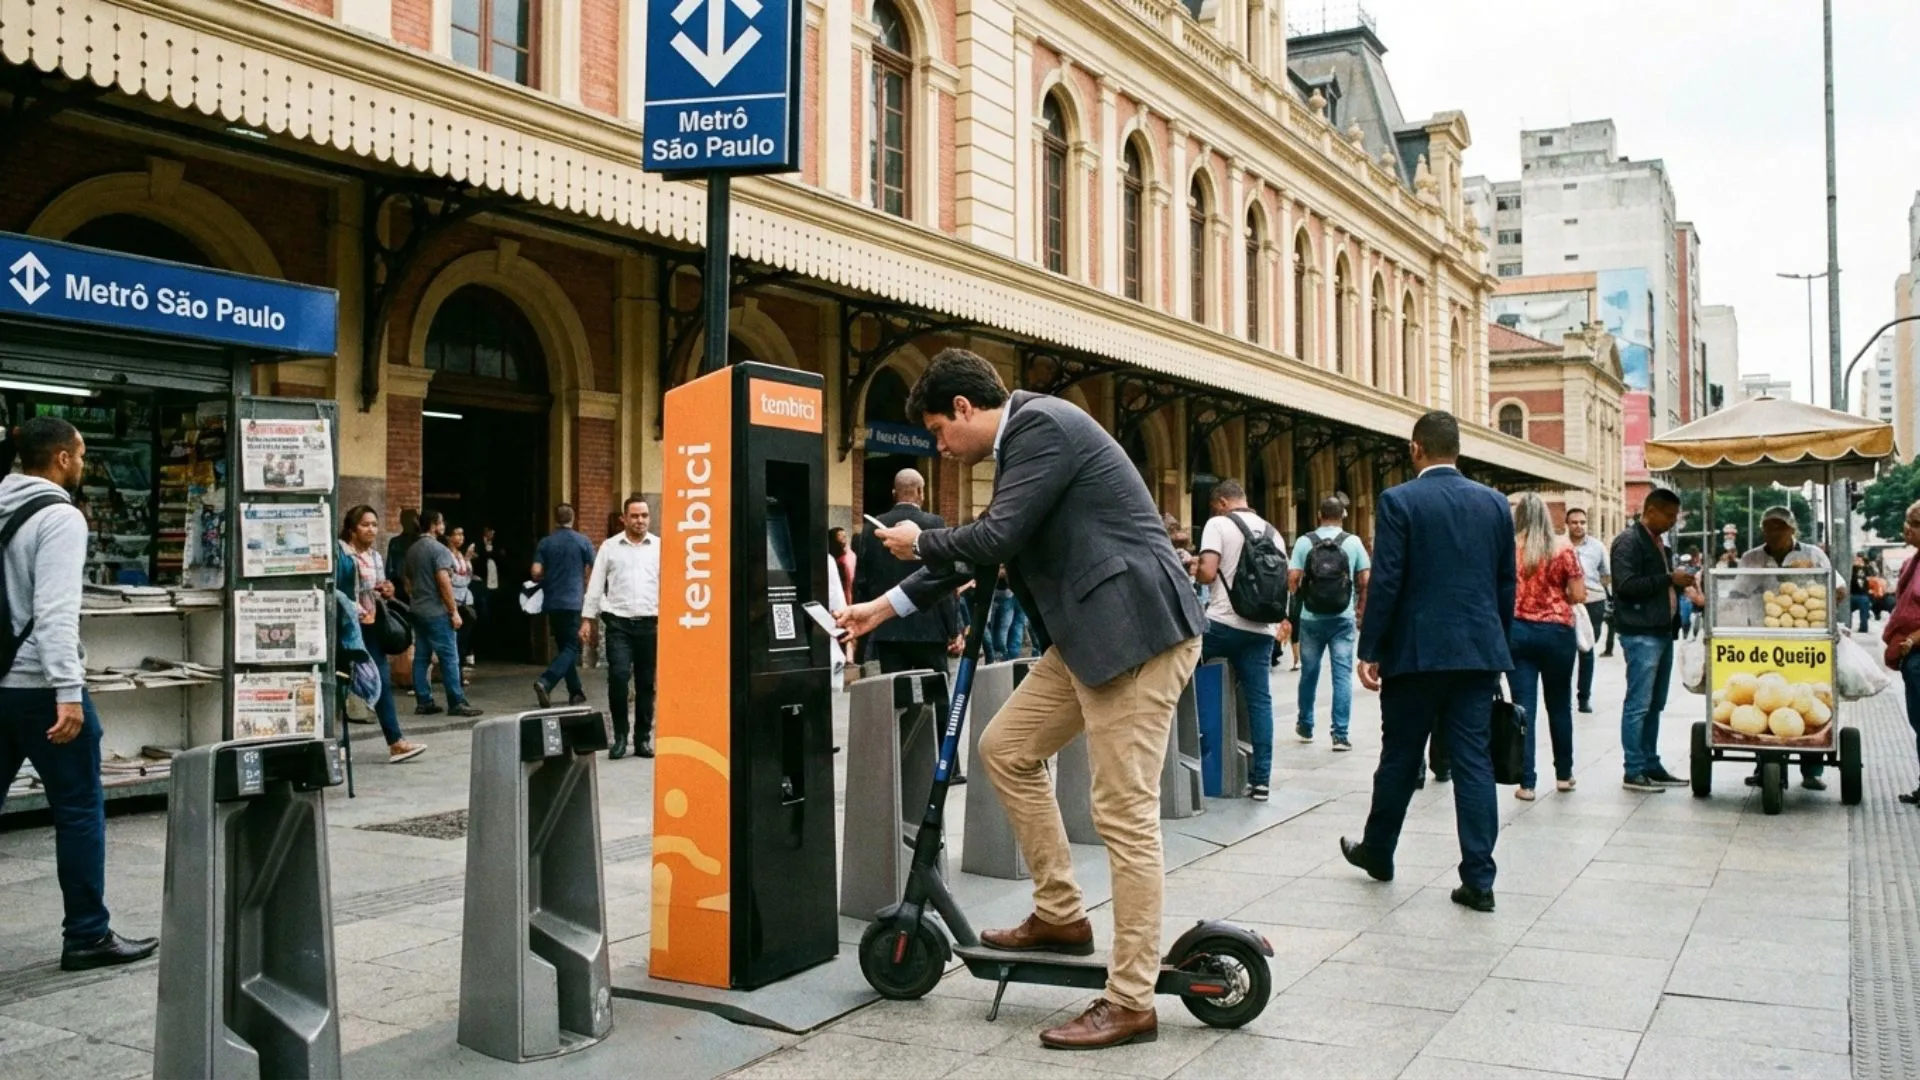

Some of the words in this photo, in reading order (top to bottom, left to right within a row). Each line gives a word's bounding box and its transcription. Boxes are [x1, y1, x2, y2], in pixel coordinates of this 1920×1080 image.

[679, 107, 748, 133] Metrô
[652, 137, 698, 161] São
[706, 134, 775, 158] Paulo
[66, 273, 149, 310] Metrô
[157, 289, 208, 319] São
[216, 297, 285, 331] Paulo
[761, 393, 816, 420] tembici
[677, 442, 712, 630] tembici
[1716, 644, 1746, 663] Pão
[1749, 646, 1769, 663] de
[1773, 646, 1826, 668] Queijo
